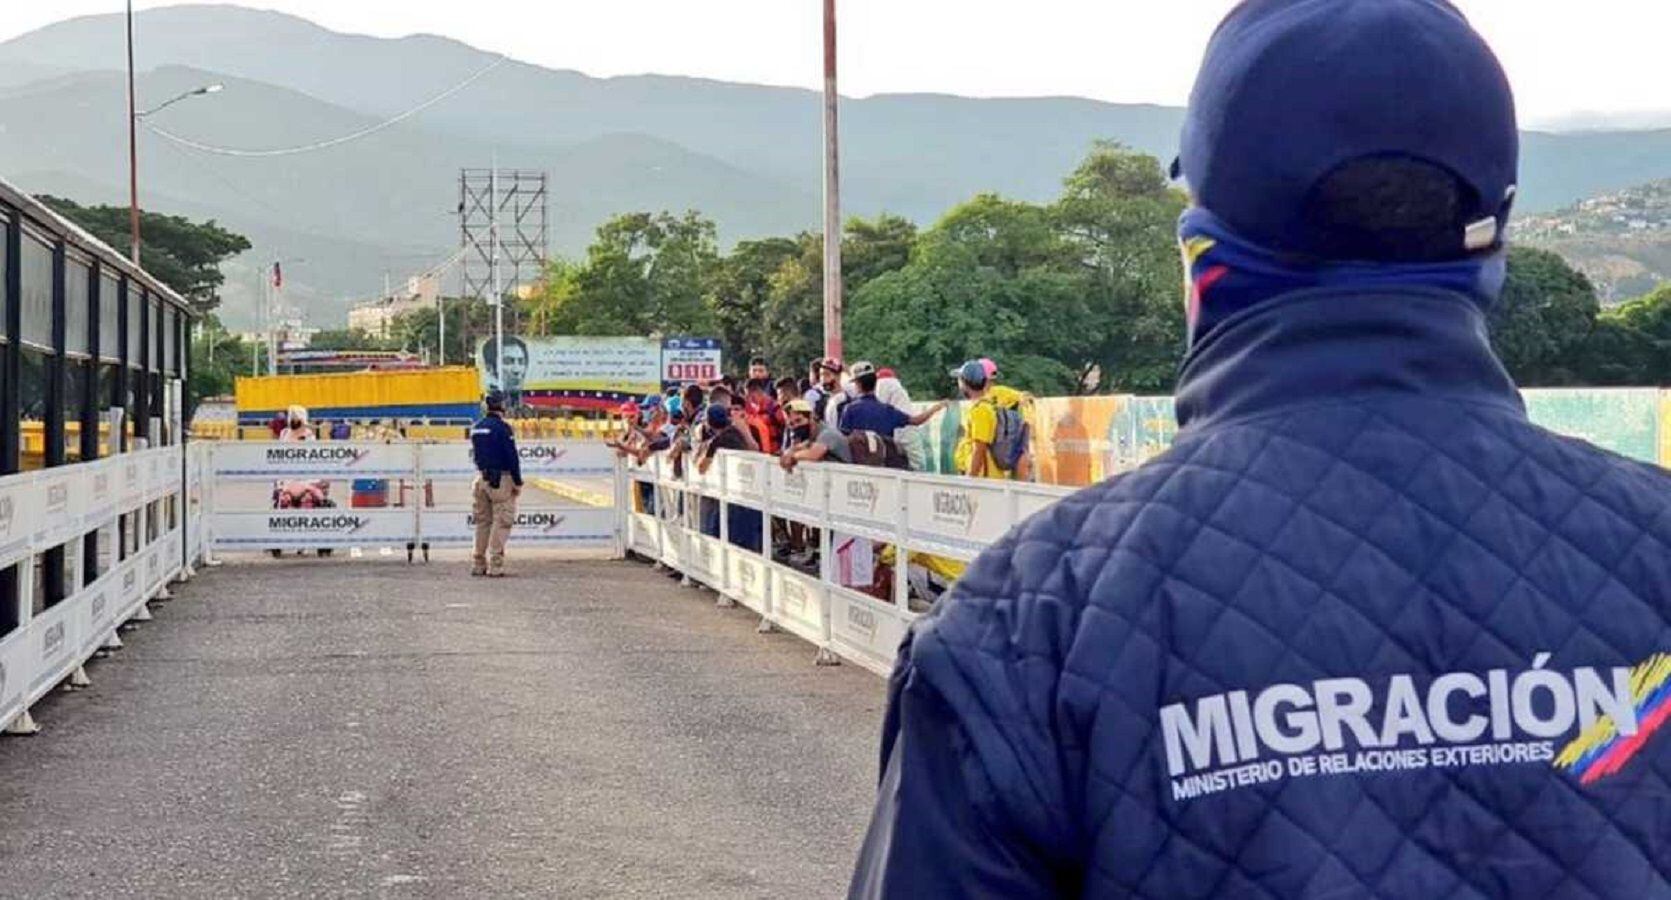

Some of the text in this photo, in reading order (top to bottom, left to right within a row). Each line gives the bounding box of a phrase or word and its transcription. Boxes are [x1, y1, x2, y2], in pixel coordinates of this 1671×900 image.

[1160, 653, 1638, 774] MIGRACIÓN
[1171, 742, 1554, 802] MINISTERIO DE RELACIONES EXTERIORES
